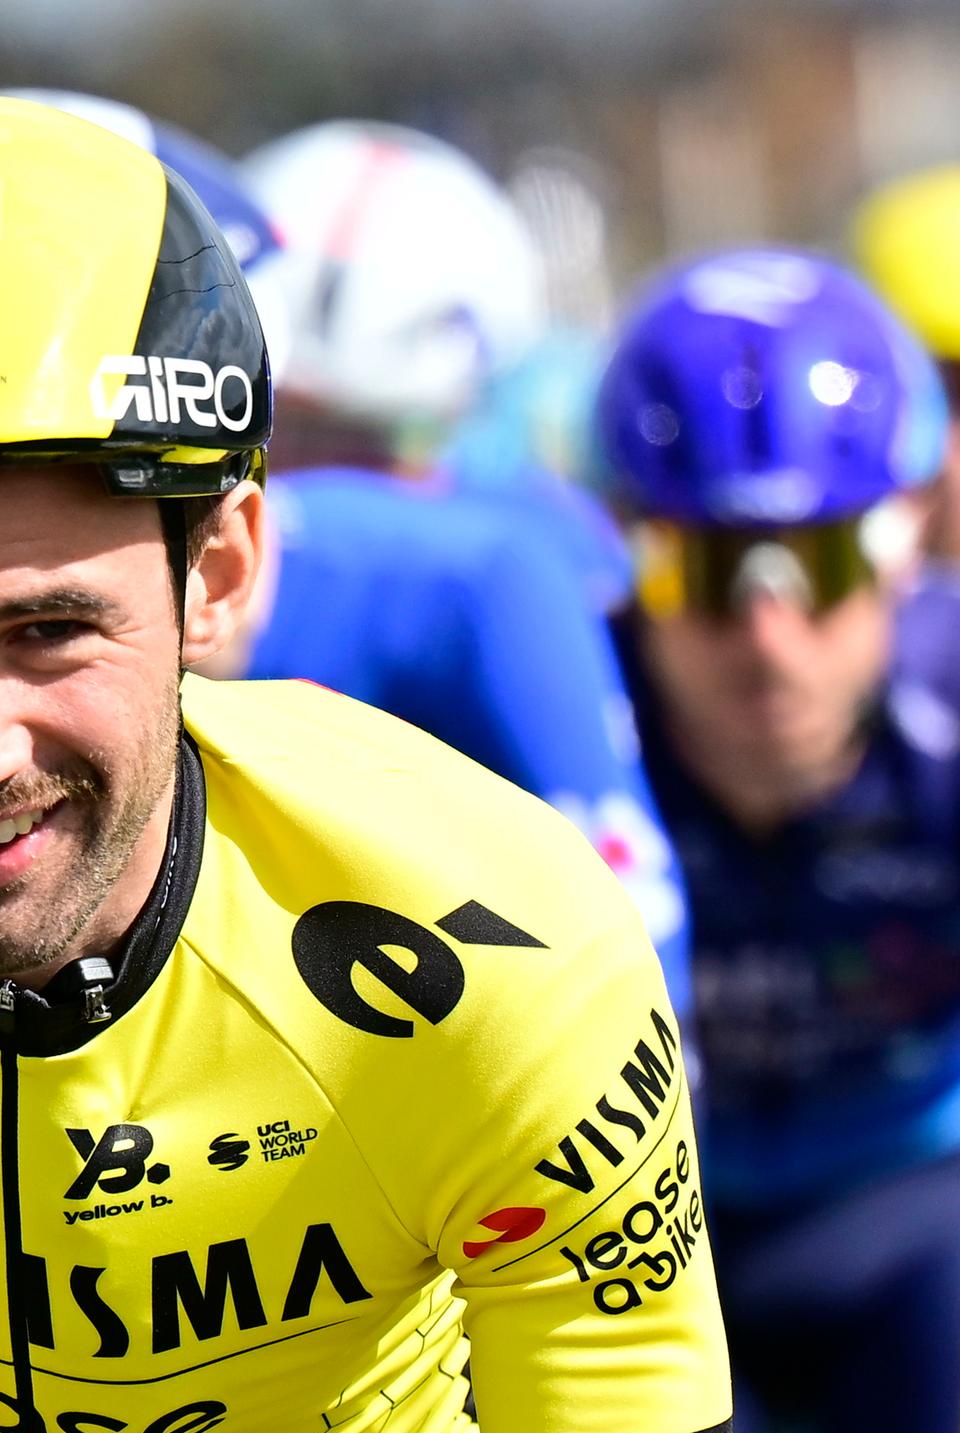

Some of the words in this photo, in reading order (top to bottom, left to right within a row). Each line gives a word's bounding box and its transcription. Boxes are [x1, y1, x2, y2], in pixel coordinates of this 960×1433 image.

[89, 355, 253, 432] GIRO
[534, 1008, 676, 1194] VISMA
[257, 1120, 290, 1137] UCI
[259, 1128, 318, 1150] WORLD
[261, 1144, 306, 1162] TEAM
[63, 1201, 144, 1225] yellow
[151, 1195, 173, 1208] b.
[559, 1140, 689, 1282] lease
